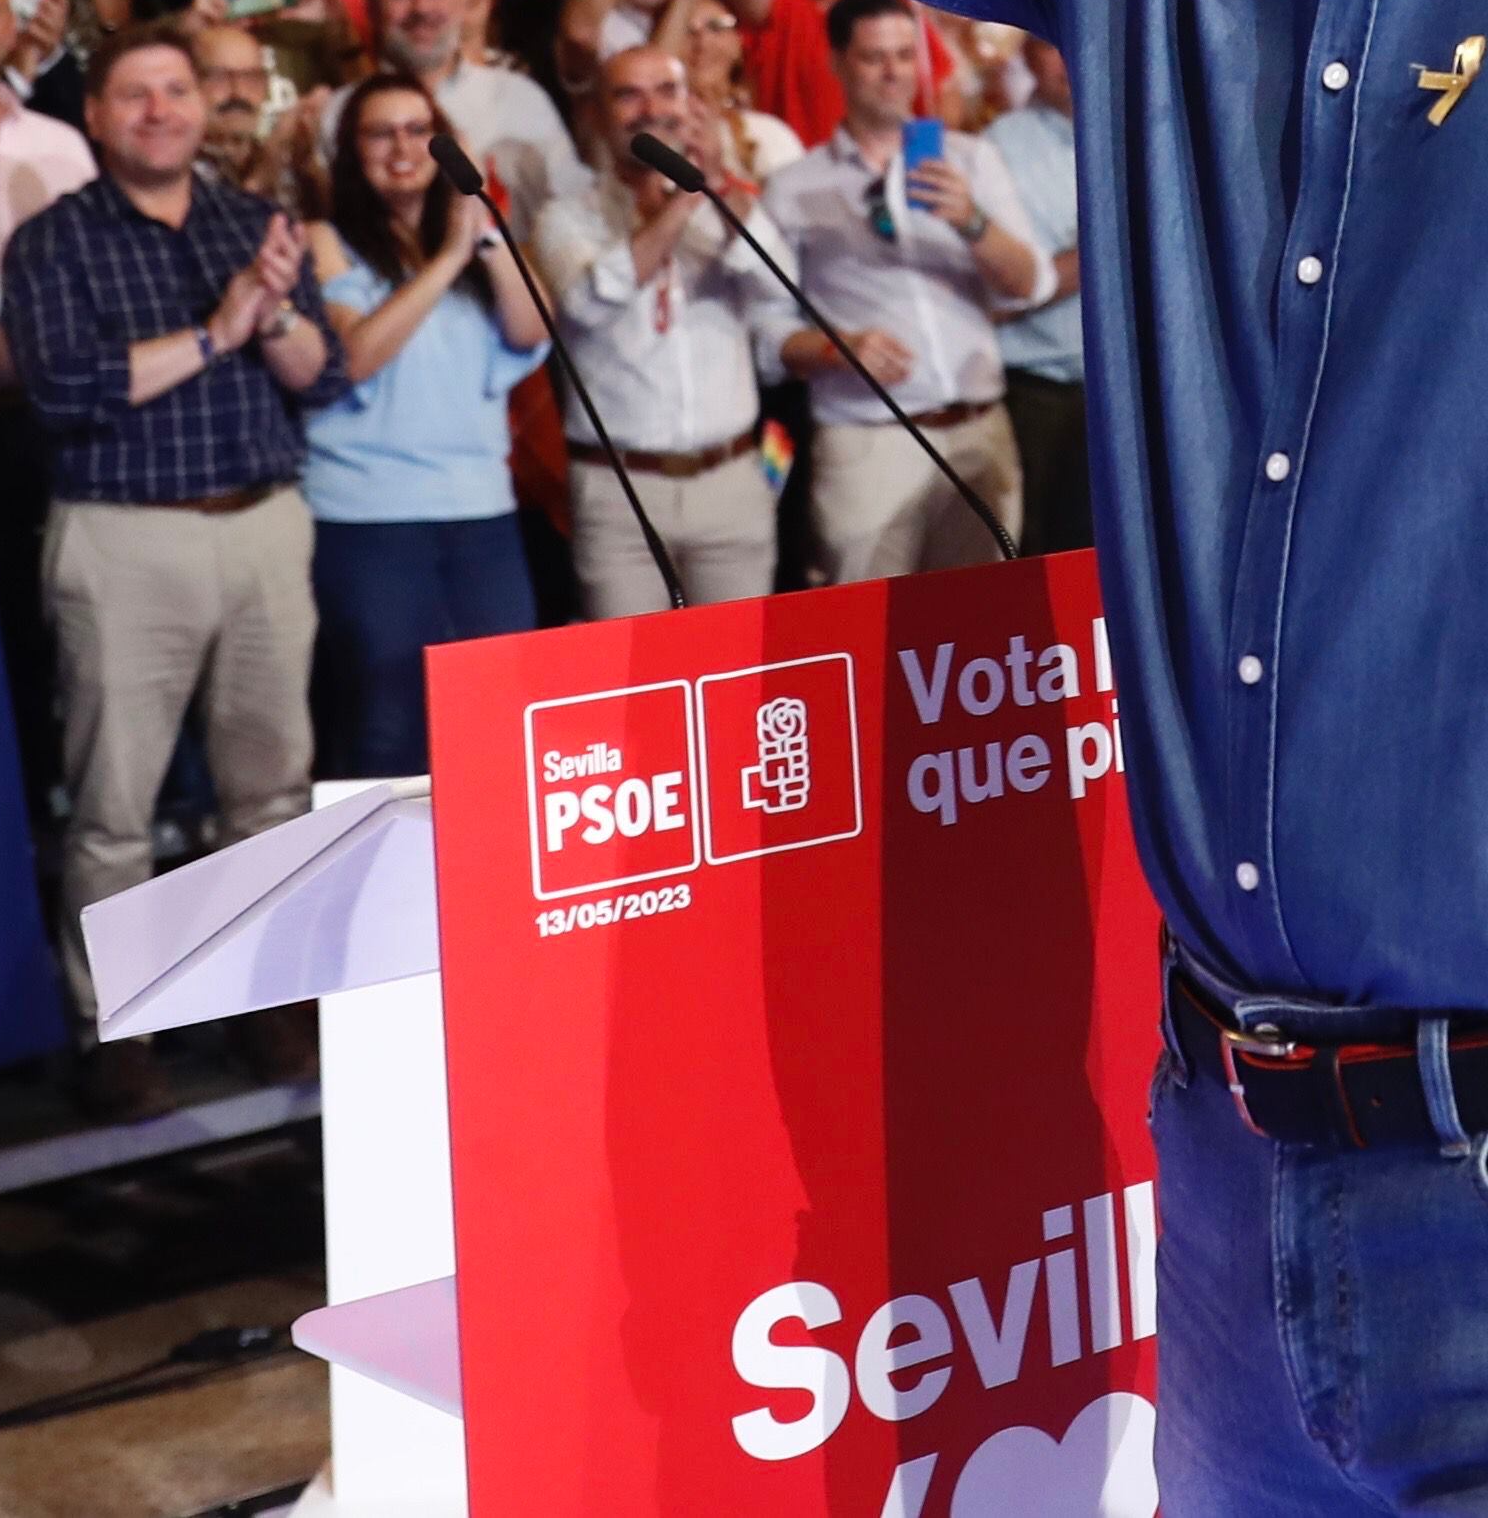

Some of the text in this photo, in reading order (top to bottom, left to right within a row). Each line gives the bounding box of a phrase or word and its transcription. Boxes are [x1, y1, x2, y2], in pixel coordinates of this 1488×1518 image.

[897, 616, 1114, 724] Vota l
[543, 742, 622, 783] Sevilla
[907, 734, 1052, 826] que
[544, 771, 686, 852] PSOE
[535, 884, 692, 938] 13/05/2023
[731, 1179, 1158, 1461] Sevill
